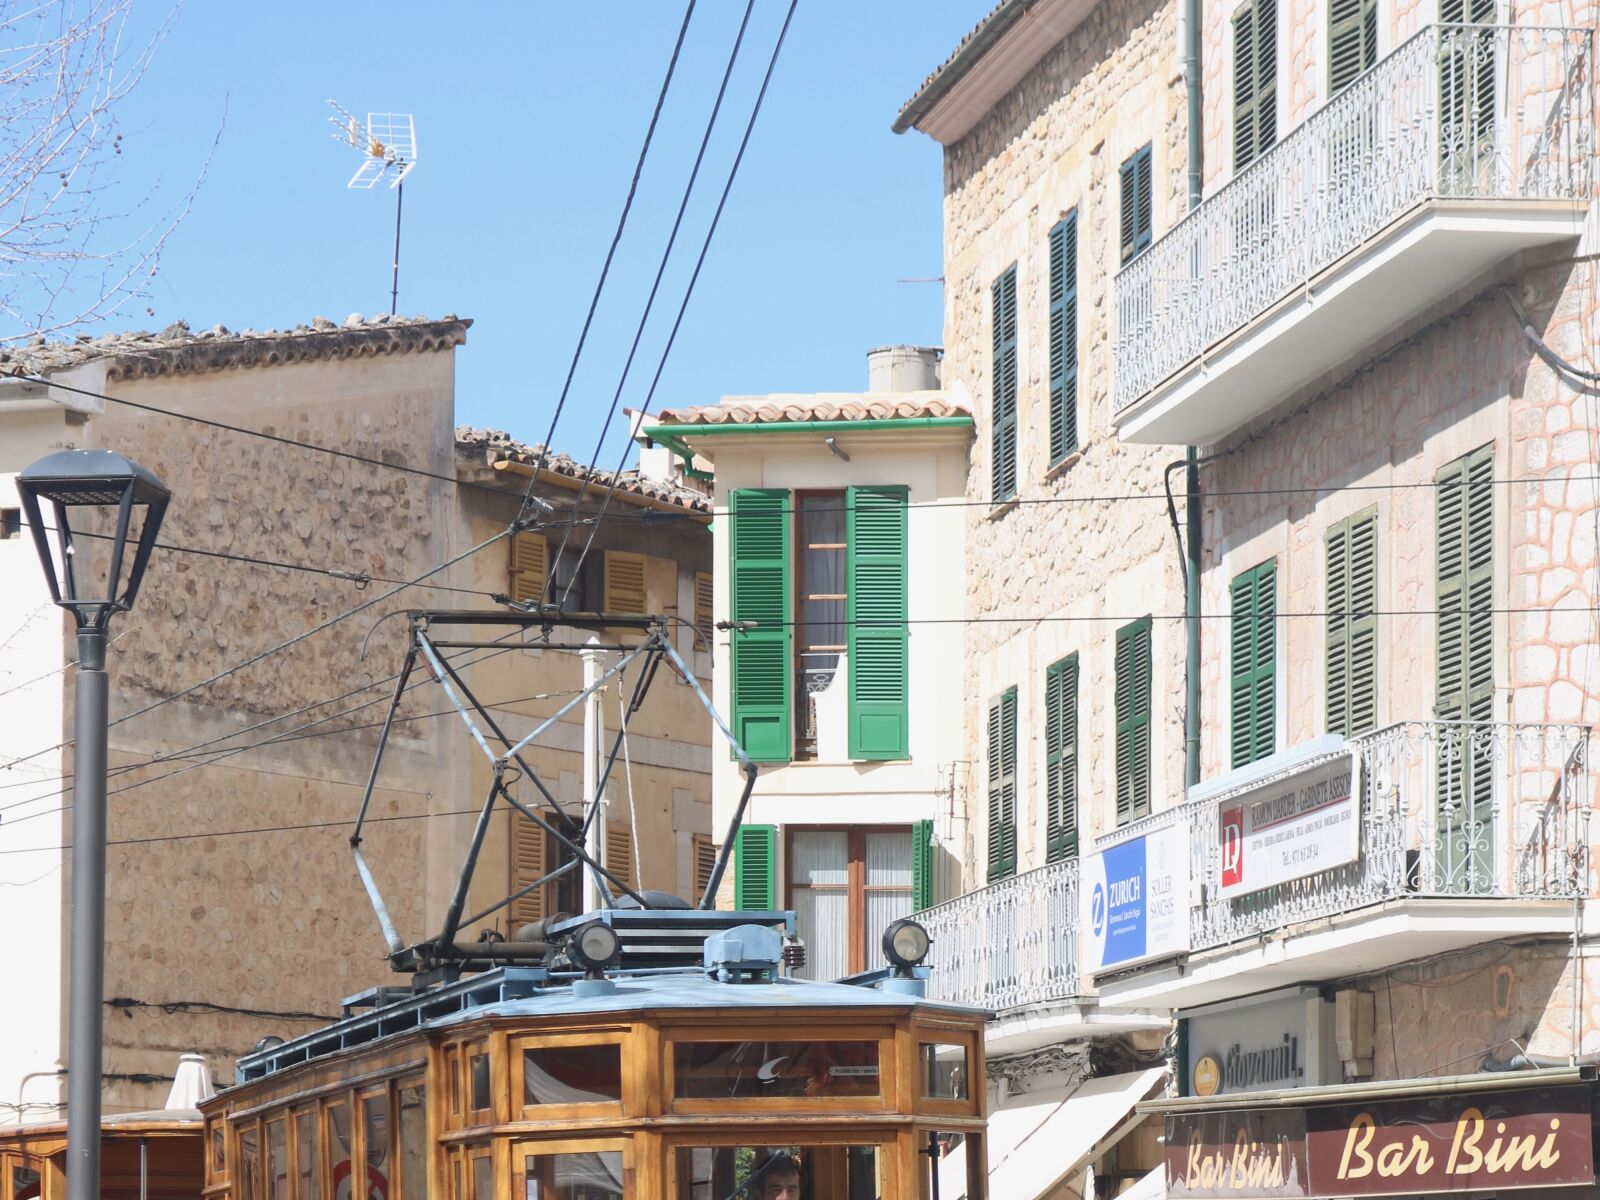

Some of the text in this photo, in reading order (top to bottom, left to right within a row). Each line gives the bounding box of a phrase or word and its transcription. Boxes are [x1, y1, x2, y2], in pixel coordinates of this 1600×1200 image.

[1109, 875, 1140, 909] ZURICH
[1225, 1033, 1290, 1088] Giovanni
[1185, 1127, 1284, 1189] Bar Bini
[1336, 1107, 1561, 1180] Bar Bini
